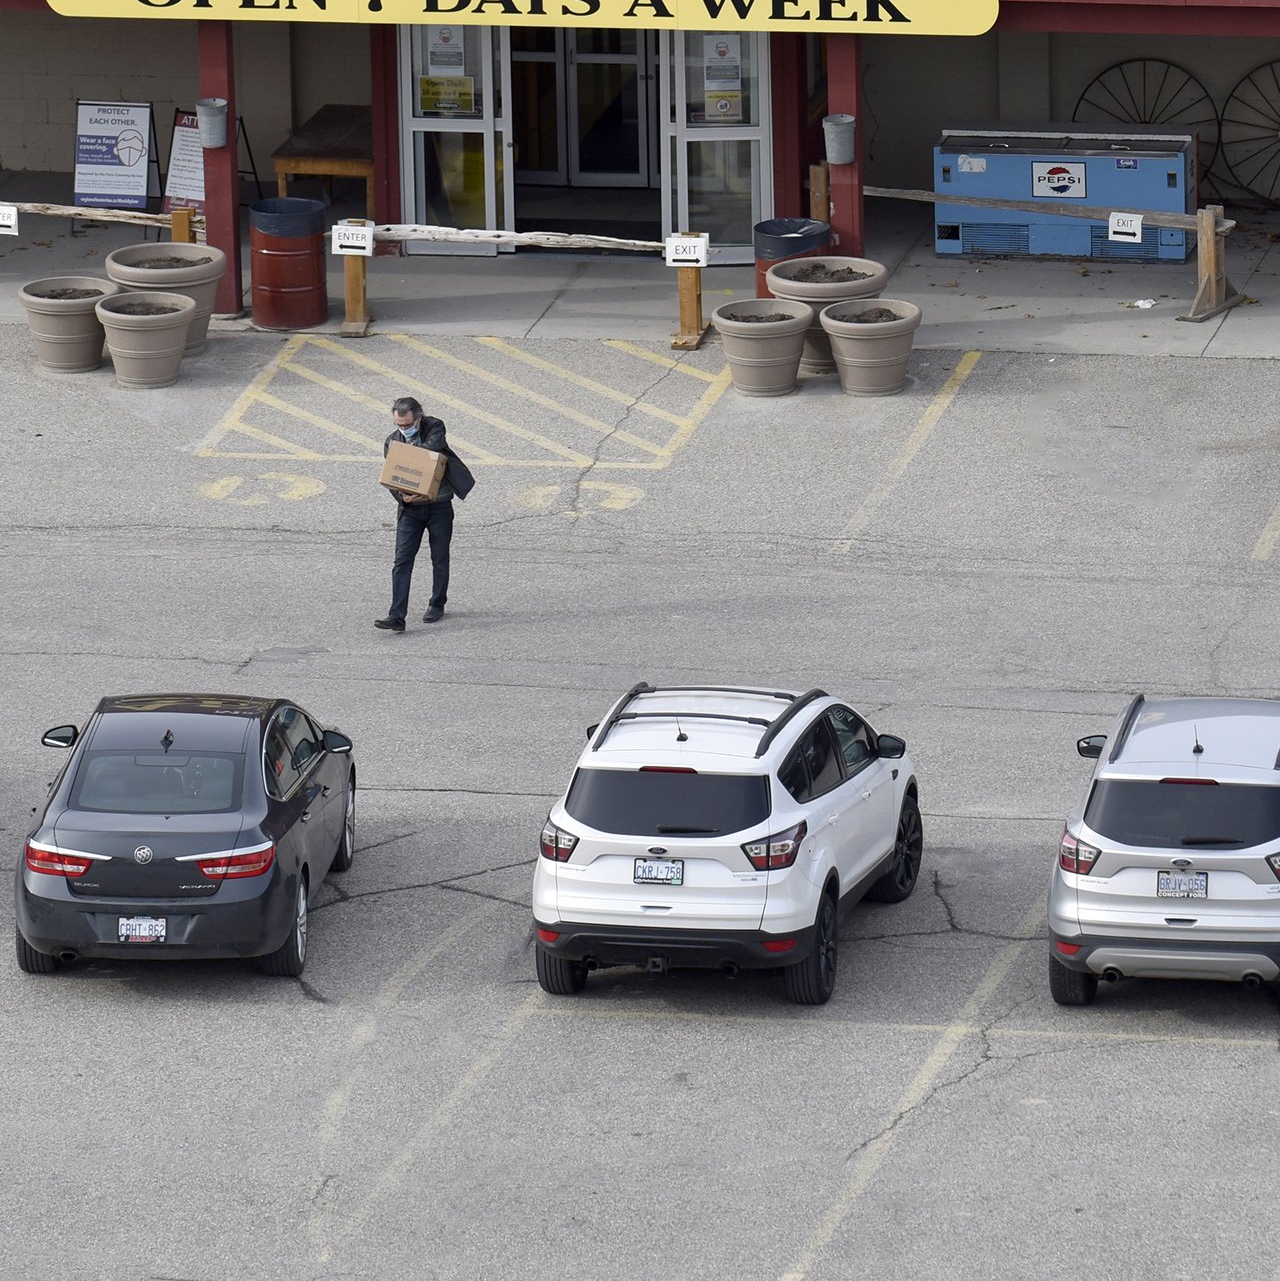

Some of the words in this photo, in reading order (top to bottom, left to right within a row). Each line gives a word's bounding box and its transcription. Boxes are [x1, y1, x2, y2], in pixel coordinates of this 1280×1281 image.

[97, 107, 131, 116] PROTECT
[111, 118, 138, 126] OTHER.
[80, 136, 97, 144] Wear
[103, 137, 116, 145] face
[79, 144, 108, 152] covering.
[1037, 176, 1081, 184] PEPSI
[1116, 219, 1134, 228] EXIT
[337, 232, 367, 242] ENTER
[675, 245, 698, 255] EXIT
[636, 865, 659, 879] CKRJ
[665, 866, 681, 880] 758
[1189, 878, 1205, 891] 056
[120, 923, 142, 935] CBHT
[148, 924, 165, 936] 862
